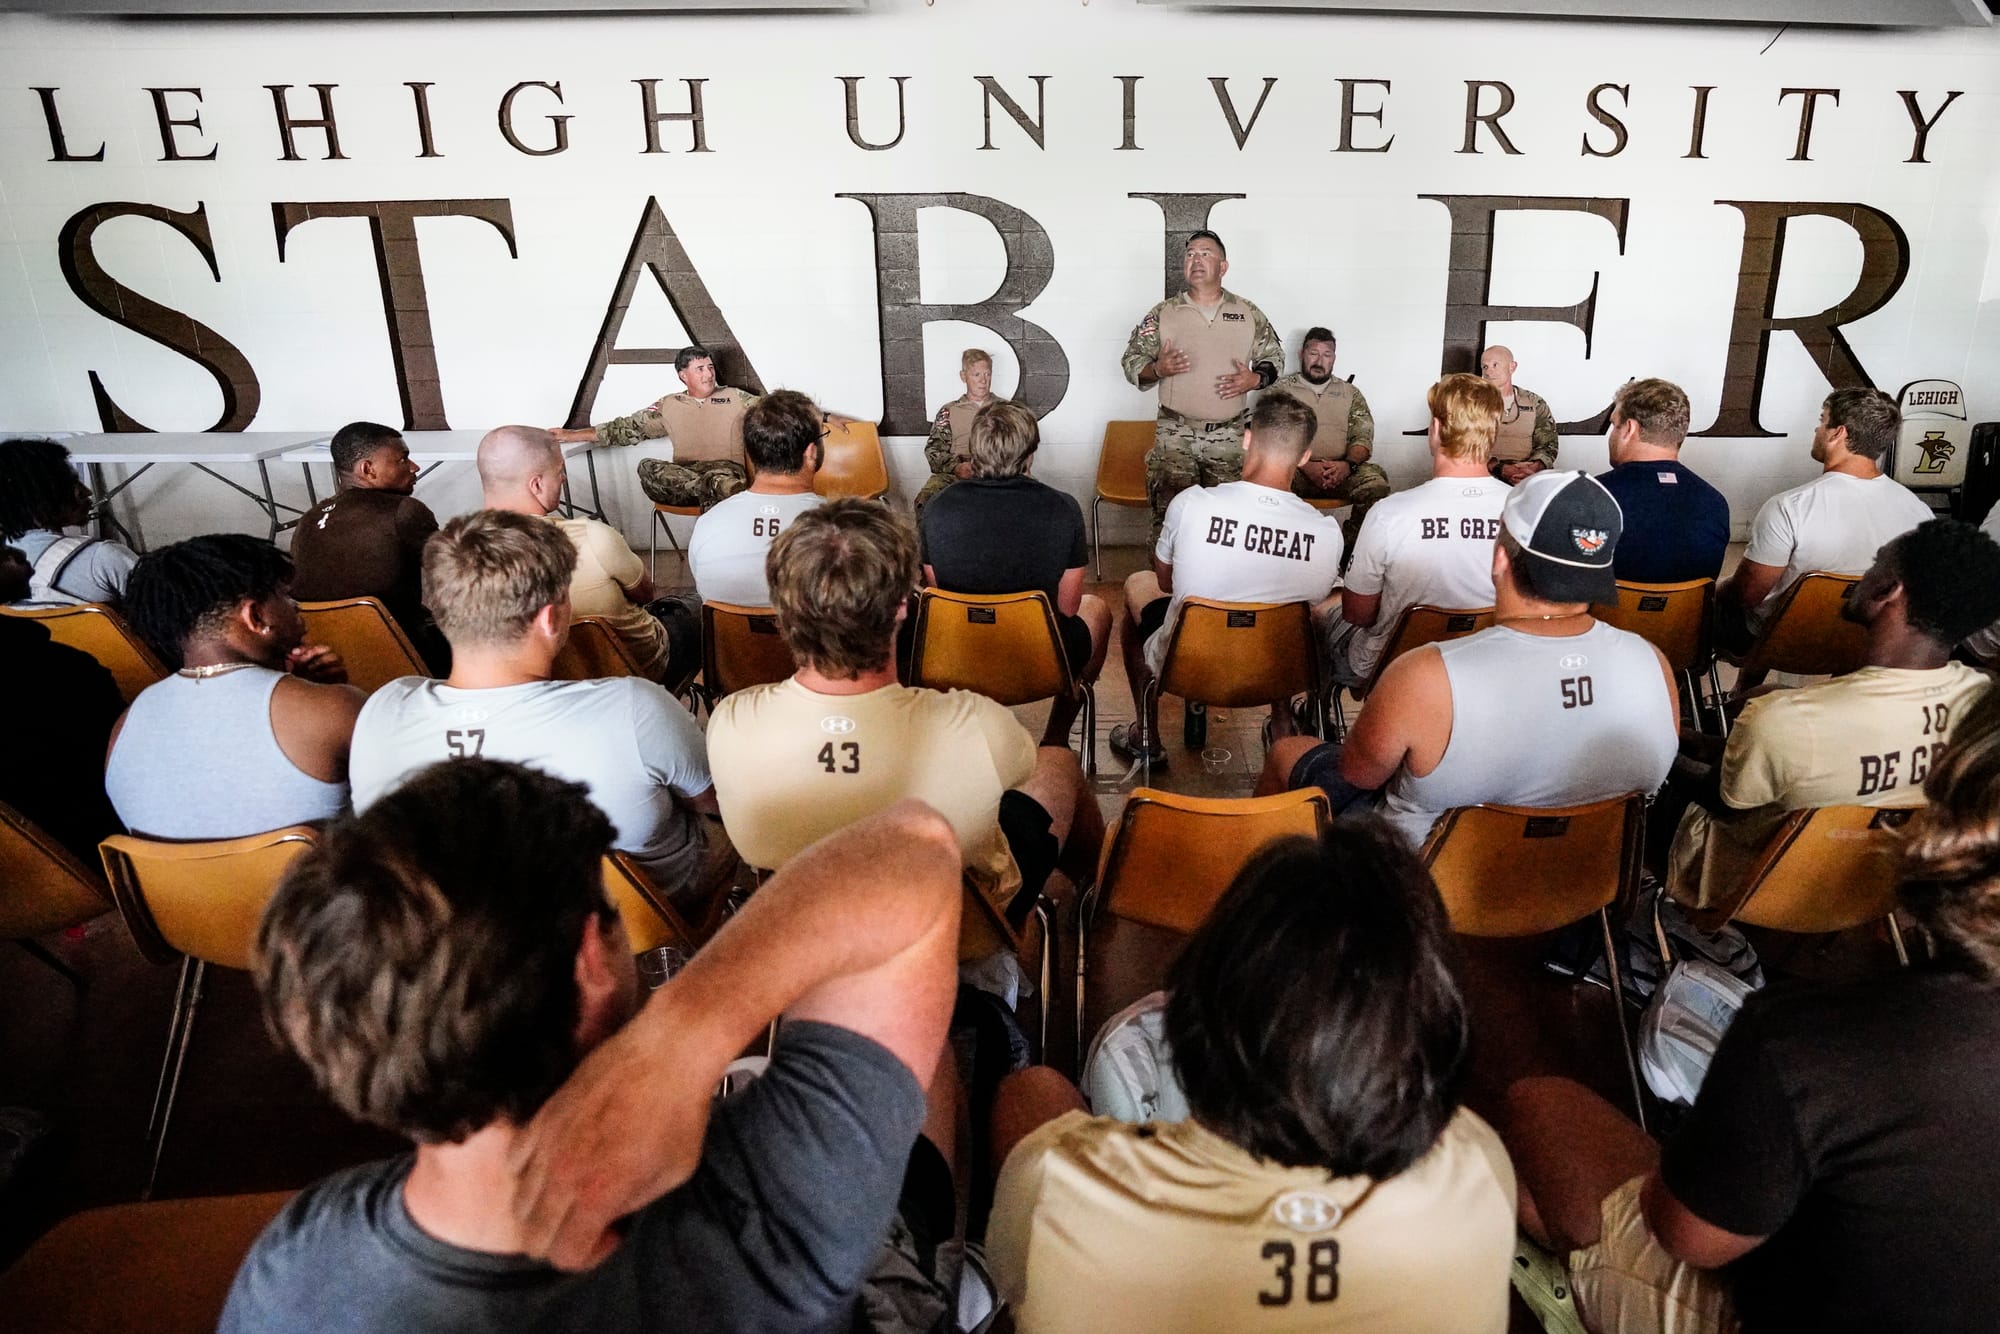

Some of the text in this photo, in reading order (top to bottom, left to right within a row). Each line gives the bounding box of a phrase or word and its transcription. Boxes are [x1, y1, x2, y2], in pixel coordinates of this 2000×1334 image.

[29, 75, 1965, 164] LEHIGH UNIVERSITY
[1909, 391, 1959, 406] LEHIGH
[753, 517, 781, 537] 66
[1205, 516, 1316, 562] BE GREAT
[1421, 517, 1500, 540] BE GRE
[1560, 675, 1594, 710] 50
[1922, 703, 1950, 735] 10
[446, 728, 486, 760] 57
[817, 741, 860, 774] 43
[1856, 750, 1901, 797] BE
[1257, 1238, 1340, 1307] 38
